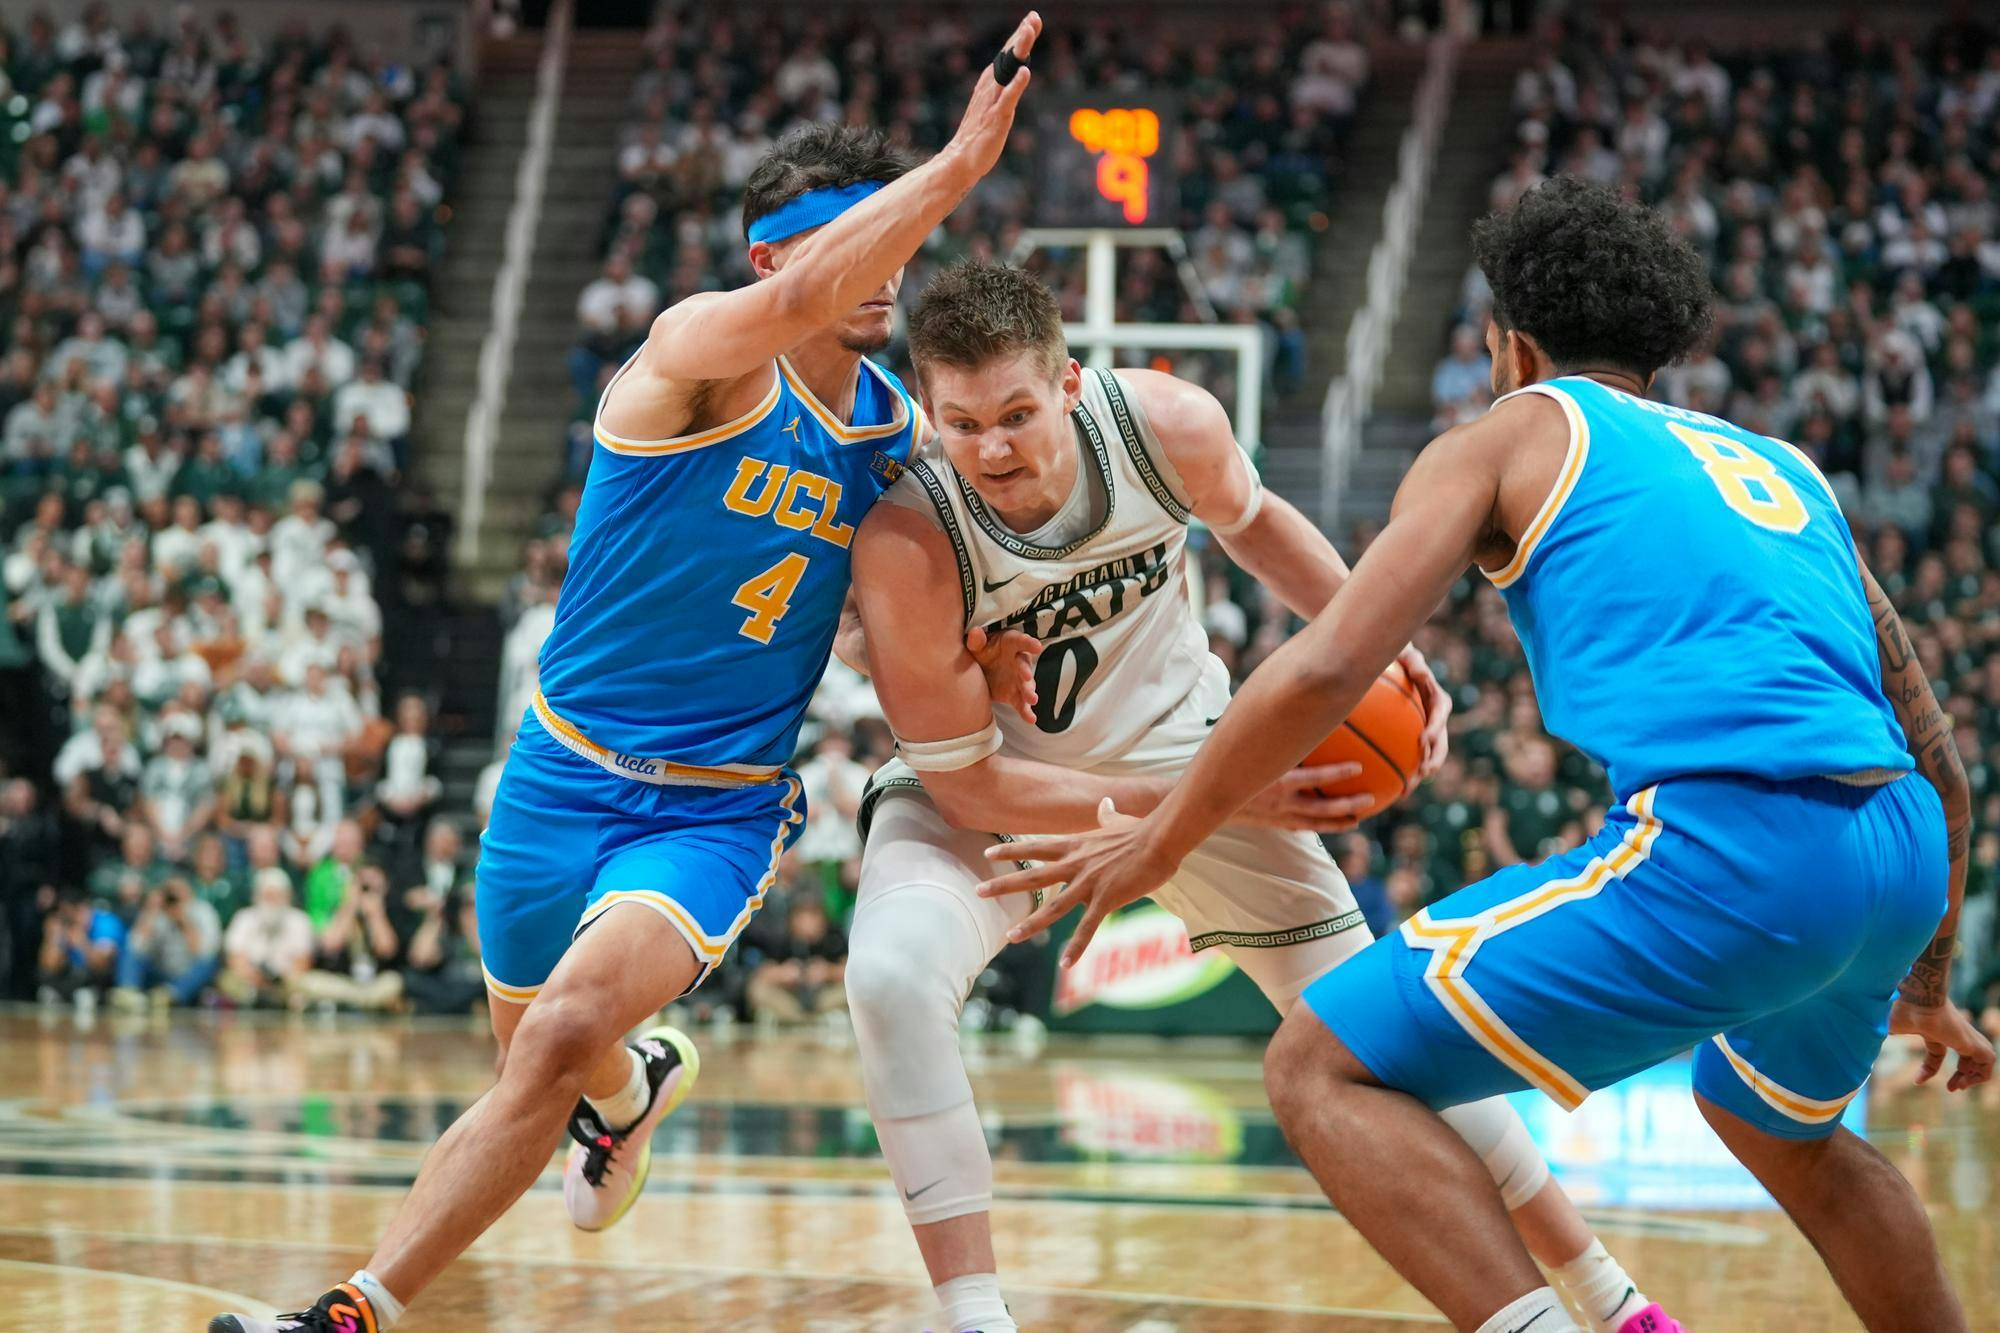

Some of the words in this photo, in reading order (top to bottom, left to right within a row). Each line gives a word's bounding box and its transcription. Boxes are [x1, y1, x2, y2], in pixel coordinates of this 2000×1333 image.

[722, 456, 855, 549] UCL
[1665, 421, 1811, 534] 8
[731, 552, 810, 645] 4
[1034, 636, 1099, 734] 0
